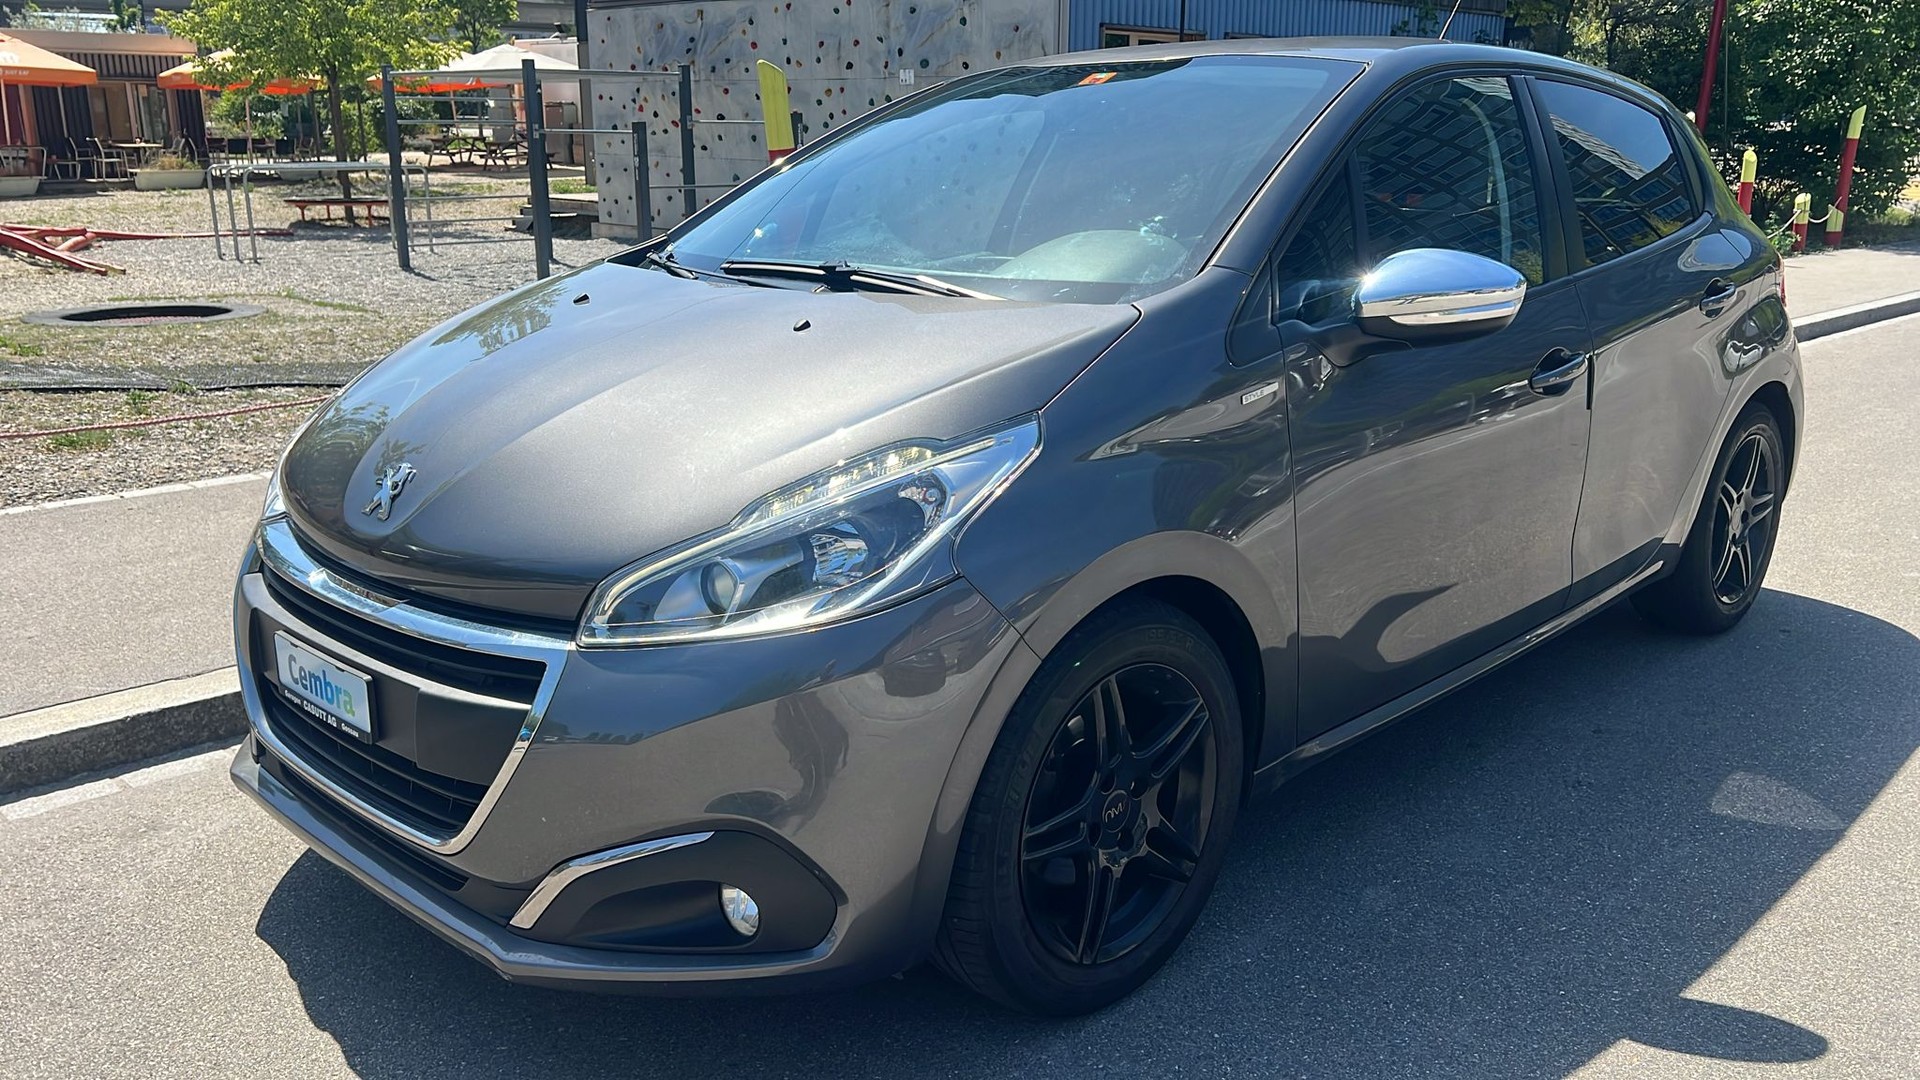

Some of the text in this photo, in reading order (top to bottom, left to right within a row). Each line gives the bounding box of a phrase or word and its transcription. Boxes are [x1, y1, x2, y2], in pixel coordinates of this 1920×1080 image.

[1244, 390, 1264, 402] STYLE
[287, 653, 356, 717] Cembra
[303, 701, 327, 722] CASUTT
[327, 714, 337, 727] AG
